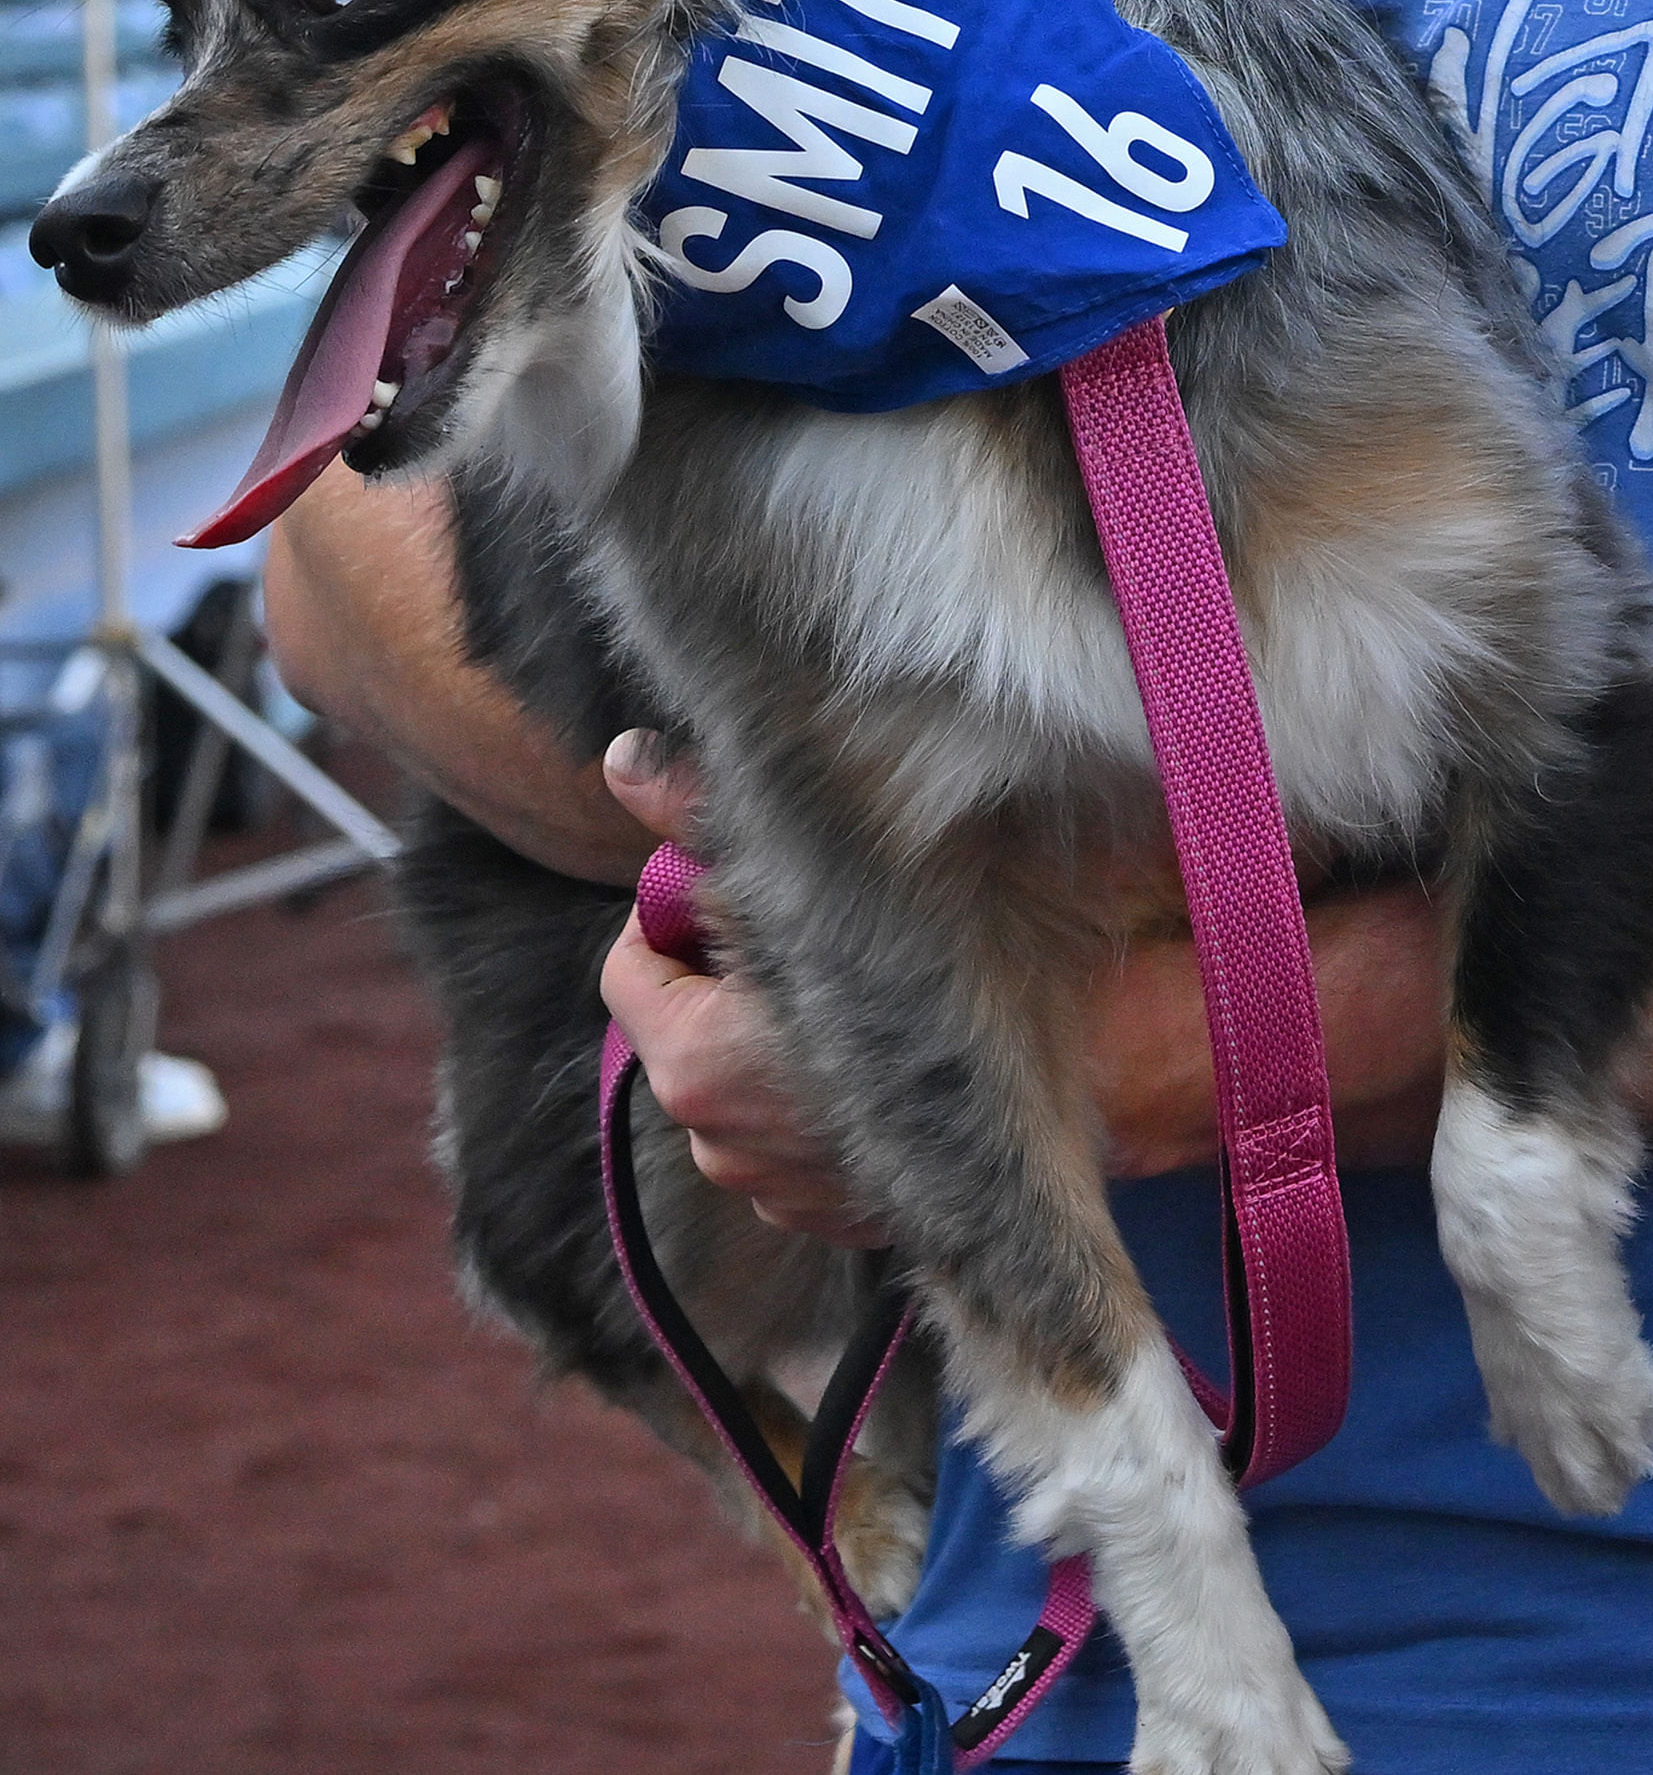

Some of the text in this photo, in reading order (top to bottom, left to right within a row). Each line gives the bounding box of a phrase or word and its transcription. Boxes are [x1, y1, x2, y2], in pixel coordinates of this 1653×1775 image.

[992, 83, 1216, 254] 16
[928, 313, 964, 342] COTTON
[934, 307, 962, 330] CHINA
[968, 334, 994, 360] MADE
